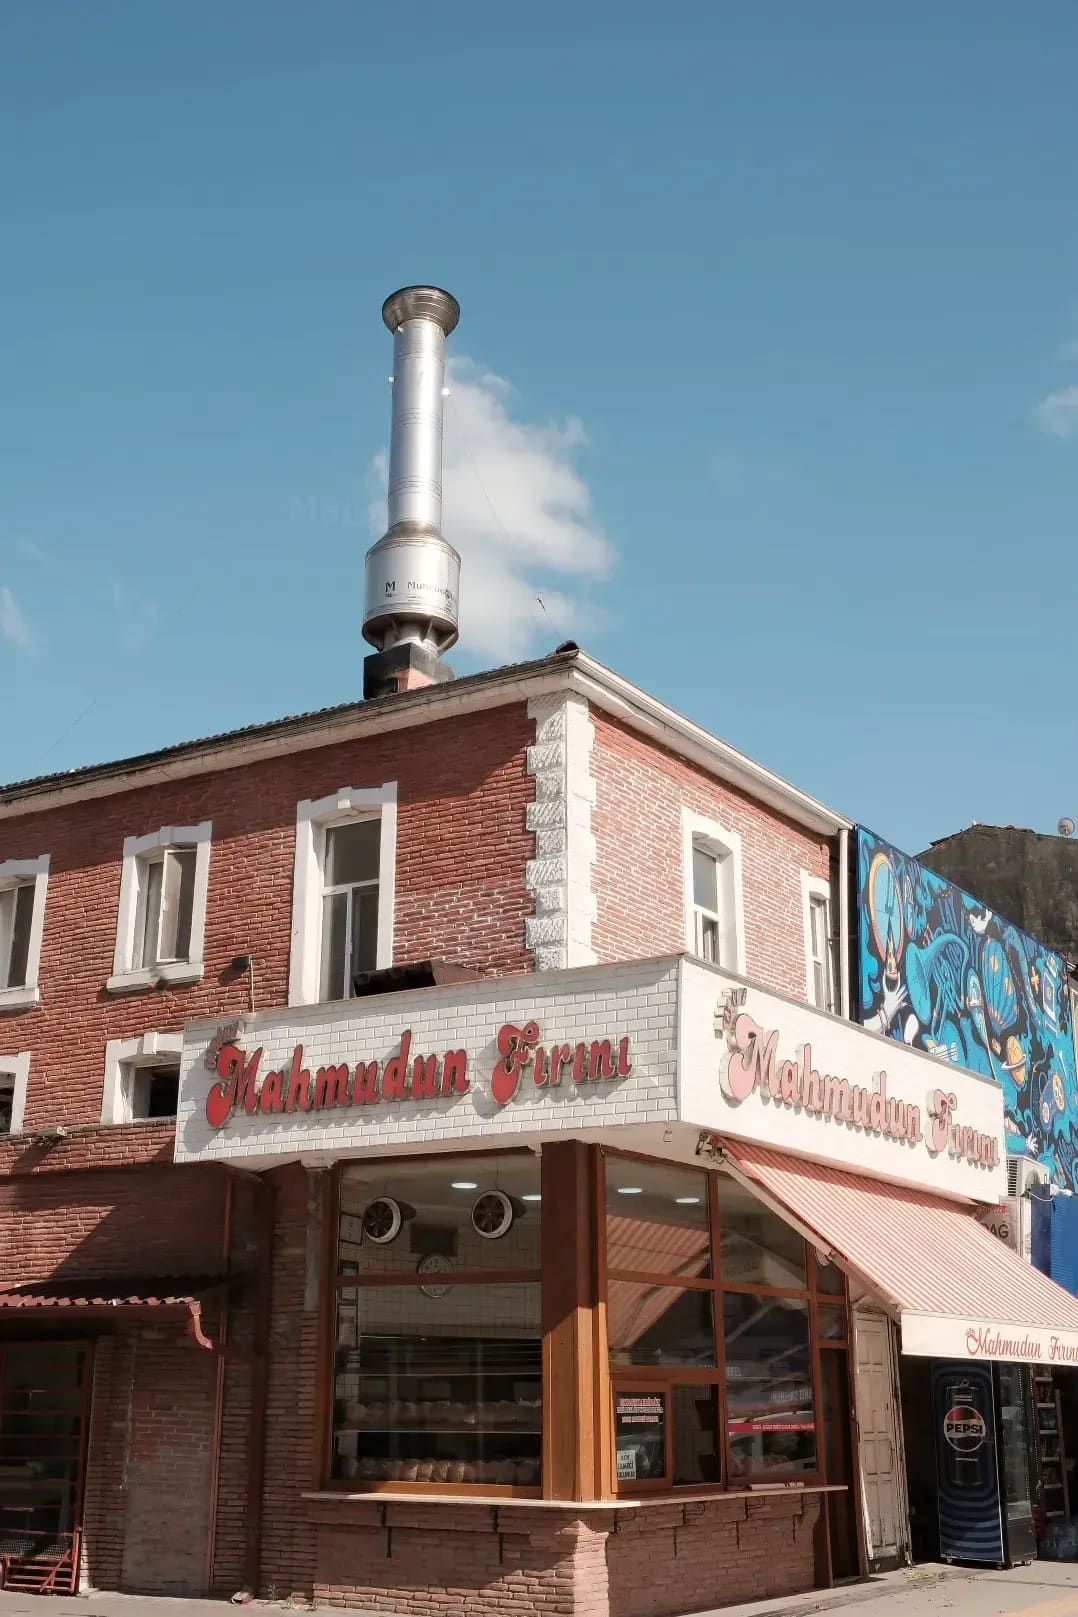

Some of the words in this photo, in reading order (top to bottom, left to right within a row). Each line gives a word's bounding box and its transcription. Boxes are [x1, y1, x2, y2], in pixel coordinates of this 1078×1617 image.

[206, 1029, 470, 1128] Mahmudun
[491, 1020, 633, 1104] Fırını
[724, 1013, 923, 1142] Mahmudun
[930, 1089, 1000, 1166] Fırını
[966, 1327, 1042, 1359] Mahmudun
[946, 1423, 983, 1434] PEPSI
